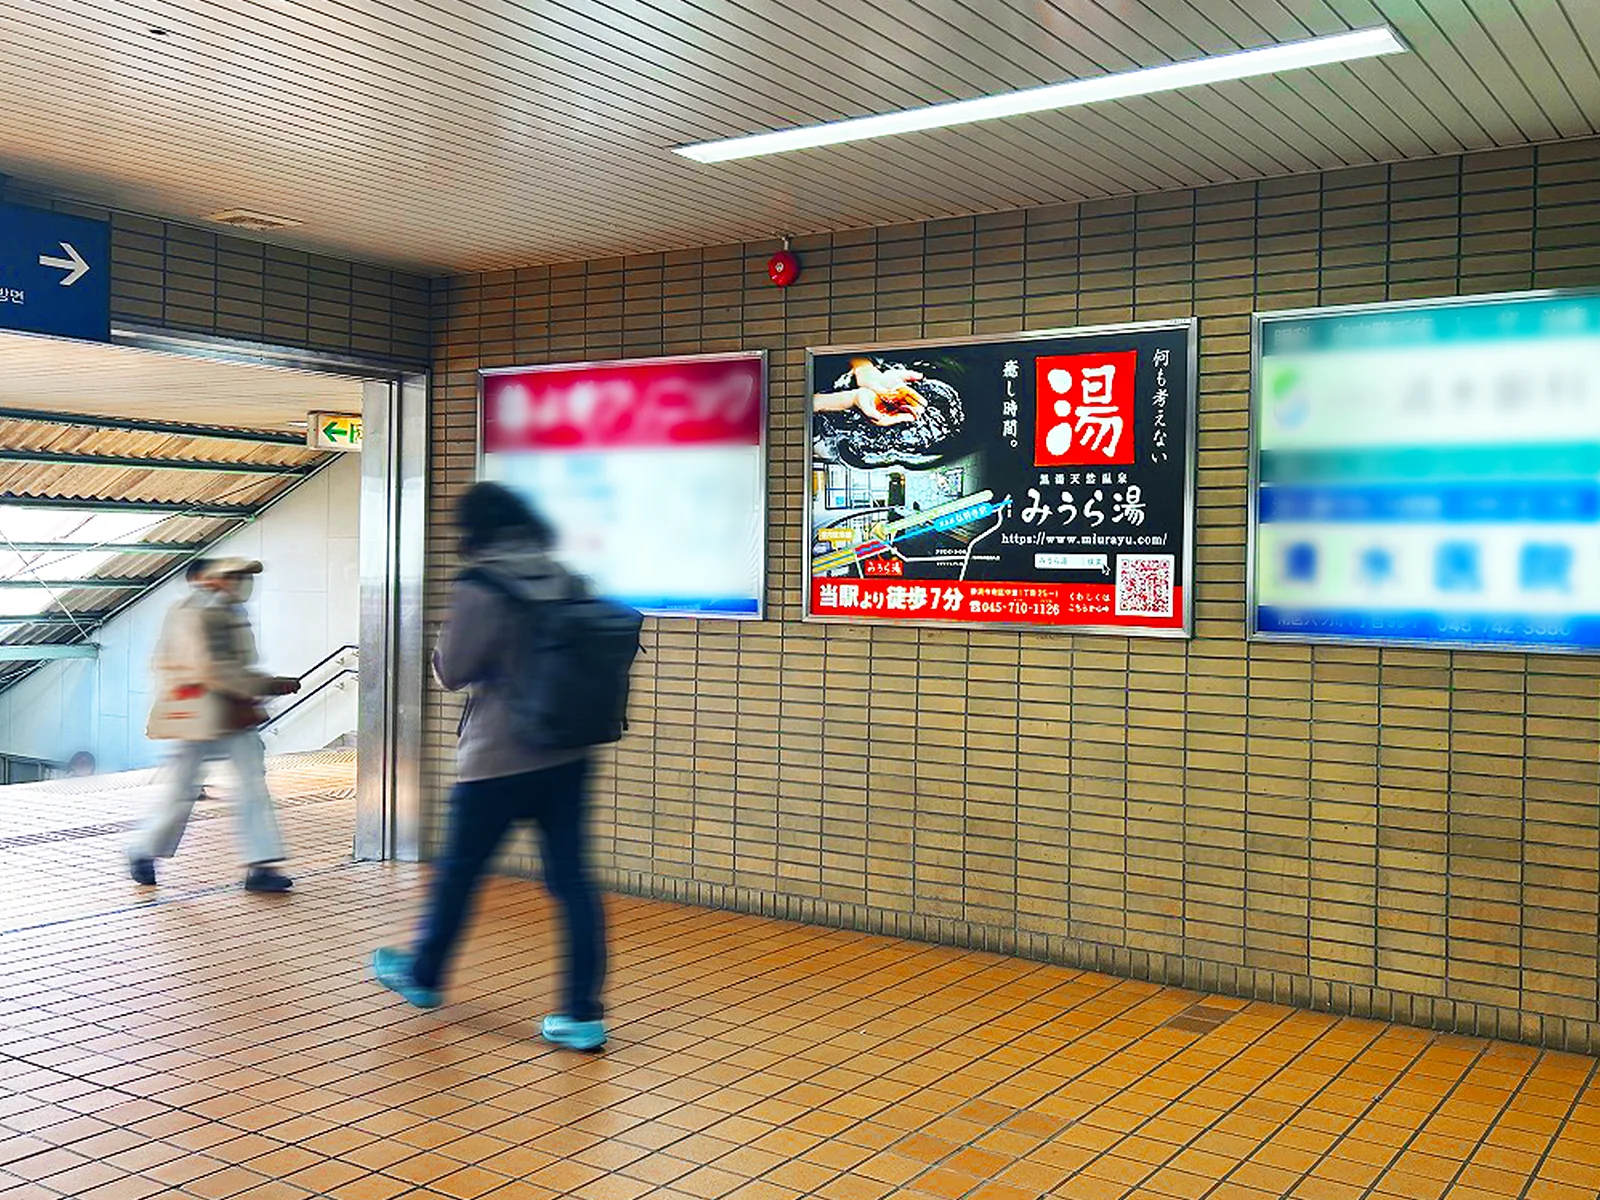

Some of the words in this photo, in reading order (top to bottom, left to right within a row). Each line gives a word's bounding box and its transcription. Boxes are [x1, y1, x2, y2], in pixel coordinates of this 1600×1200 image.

[1002, 359, 1020, 448] 癒し時間。
[1045, 364, 1124, 458] 湯
[1151, 348, 1170, 464] 何も考えない
[1001, 532, 1168, 547] https://www.miurayu.com/
[1021, 485, 1147, 528] みうら湯
[819, 583, 965, 612] 当駅より徒歩7分
